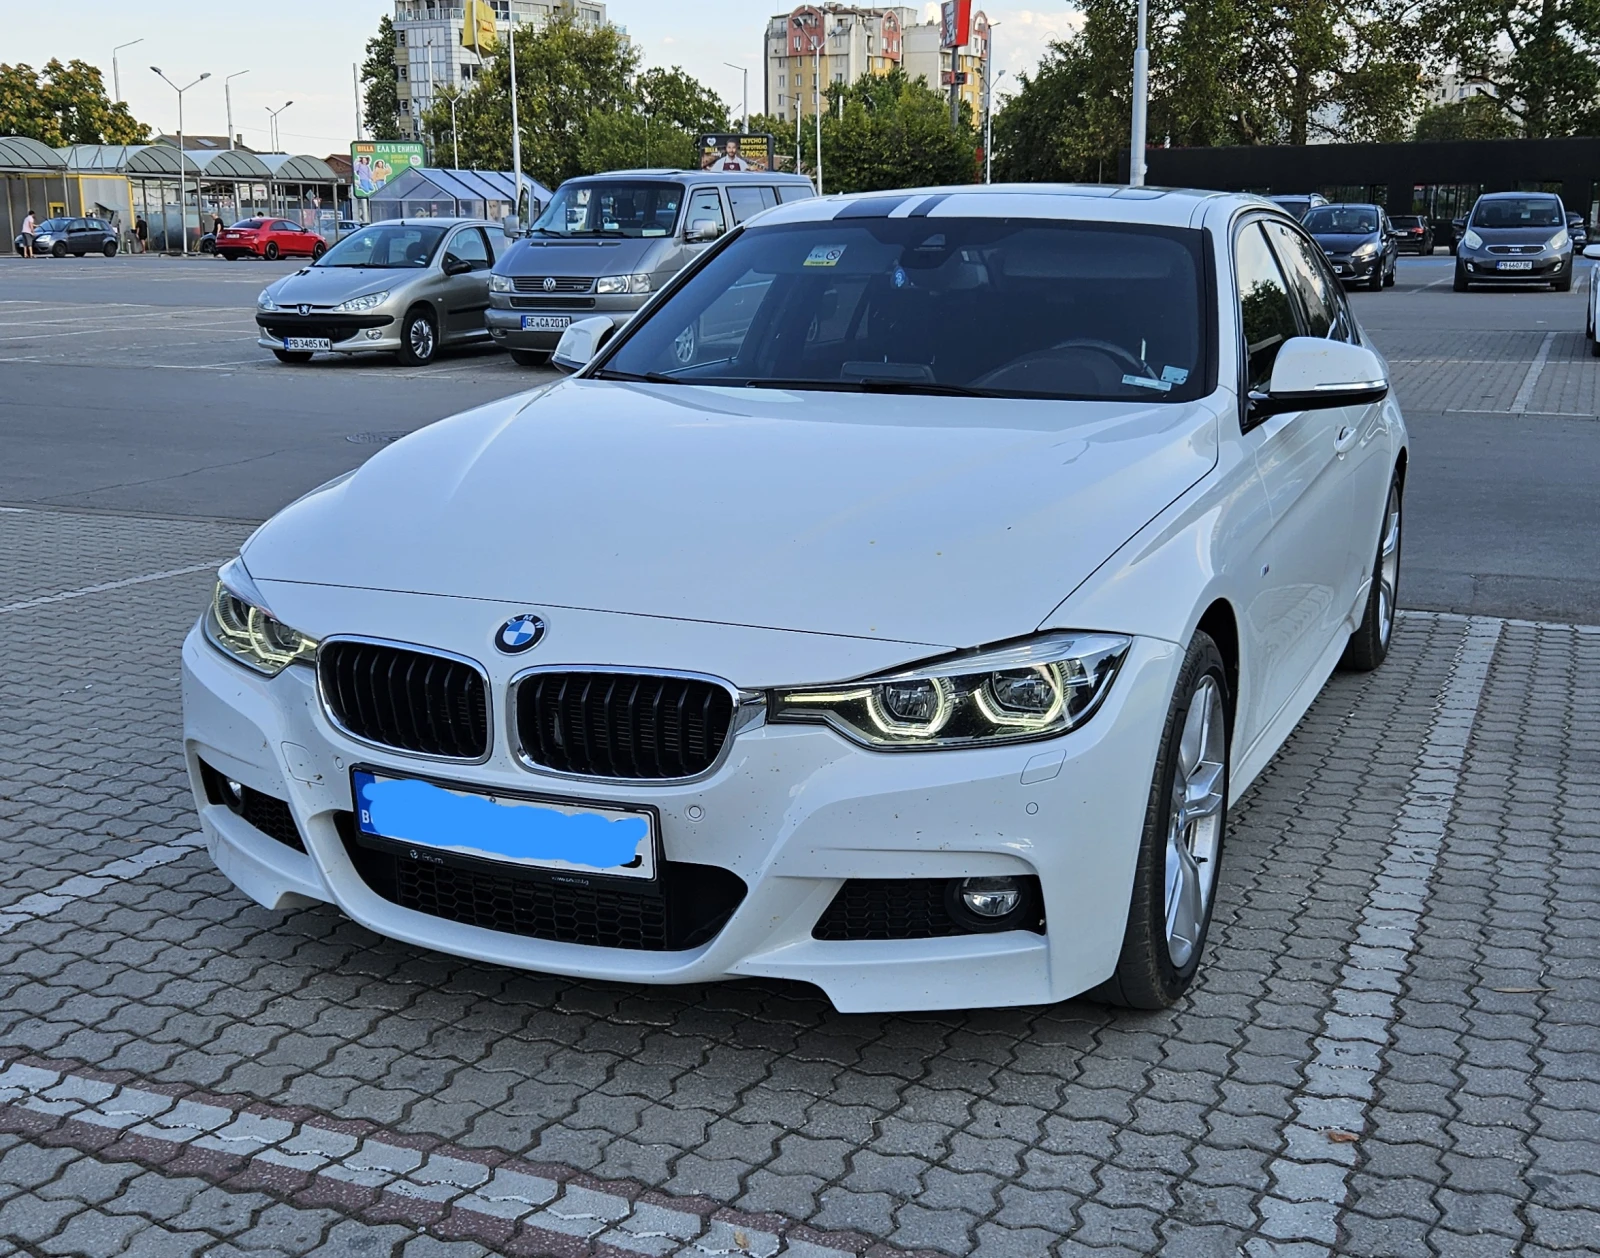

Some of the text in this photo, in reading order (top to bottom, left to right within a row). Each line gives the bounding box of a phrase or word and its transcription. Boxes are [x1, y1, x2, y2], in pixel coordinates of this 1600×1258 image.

[376, 145, 390, 153] ЕЛА
[391, 145, 396, 153] В
[526, 318, 569, 328] GE CA 2018
[289, 339, 330, 348] PB 3485 KM
[506, 614, 545, 629] BMW
[361, 809, 374, 824] B
